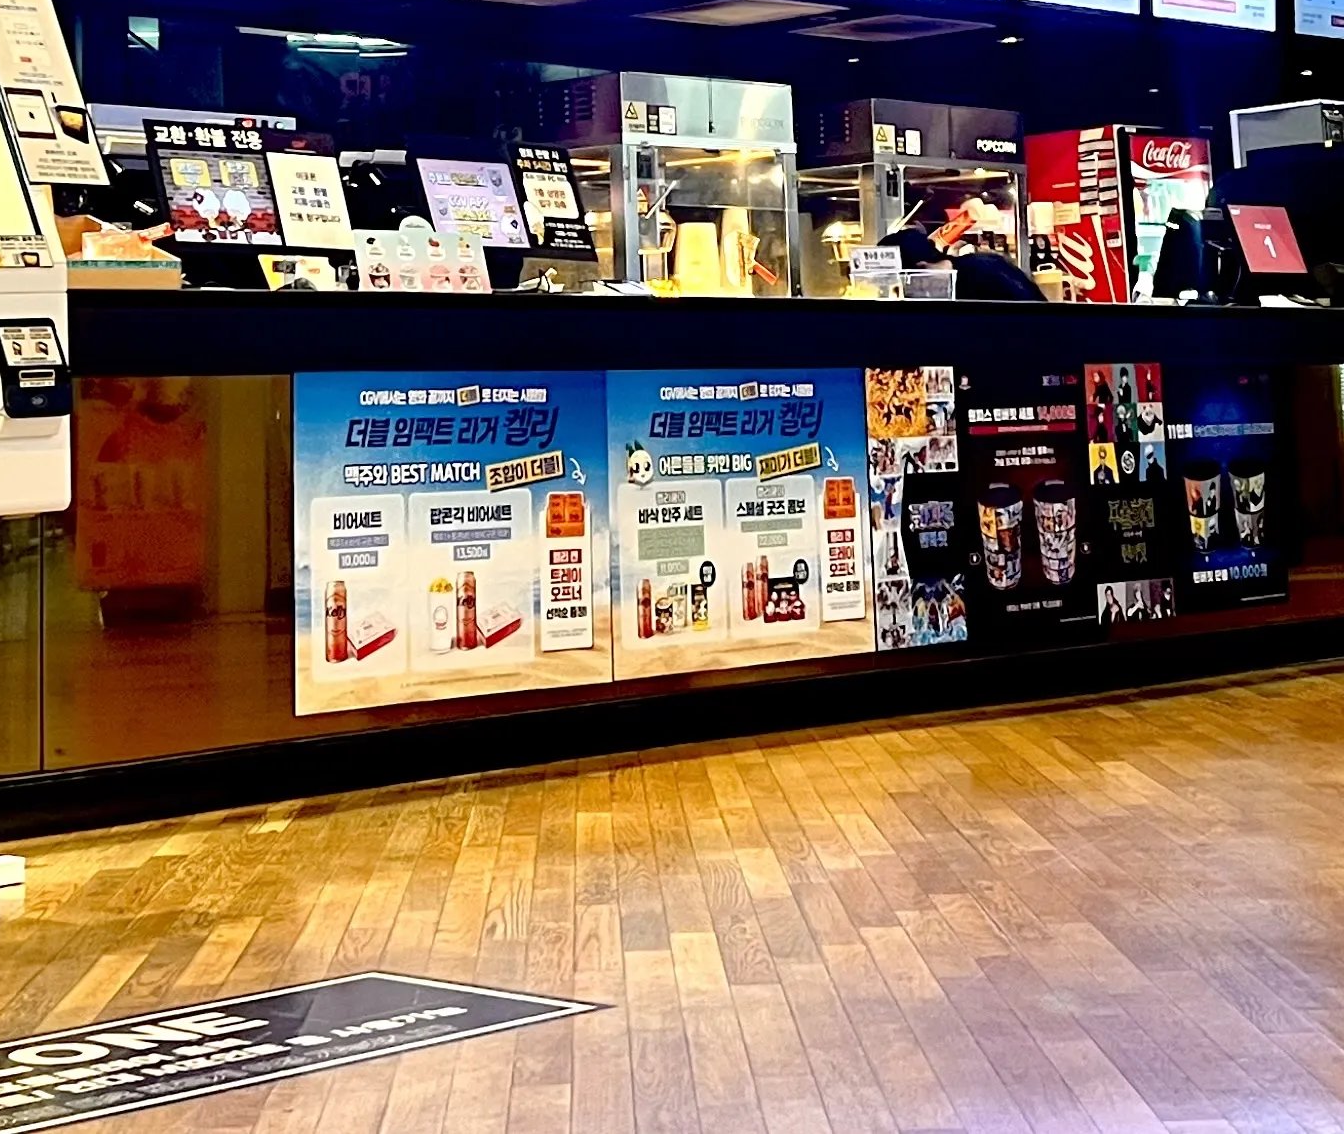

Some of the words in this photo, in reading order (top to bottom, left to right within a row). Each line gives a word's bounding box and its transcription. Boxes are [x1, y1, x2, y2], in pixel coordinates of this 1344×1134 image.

[153, 125, 227, 148] 교환·환불
[230, 130, 263, 151] 전용
[976, 138, 1016, 155] POPCORN
[345, 417, 390, 448] 더블
[393, 416, 455, 448] 임팩트
[457, 415, 500, 445] 라거
[503, 406, 560, 449] 켈리
[649, 411, 686, 438] 더블
[688, 410, 739, 438] 임팩트
[778, 399, 824, 439] 켈리
[731, 453, 752, 472] BIG
[344, 463, 389, 487] 맥주와
[391, 463, 428, 485] BEST
[431, 461, 481, 483] MATCH
[430, 506, 465, 526] 팝콘각
[467, 504, 512, 524] 비어세트
[683, 505, 703, 521] 세트
[766, 500, 786, 516] 굿즈
[333, 510, 383, 530] 비어세트
[550, 567, 582, 584] 트레이
[550, 585, 583, 602] 오프너
